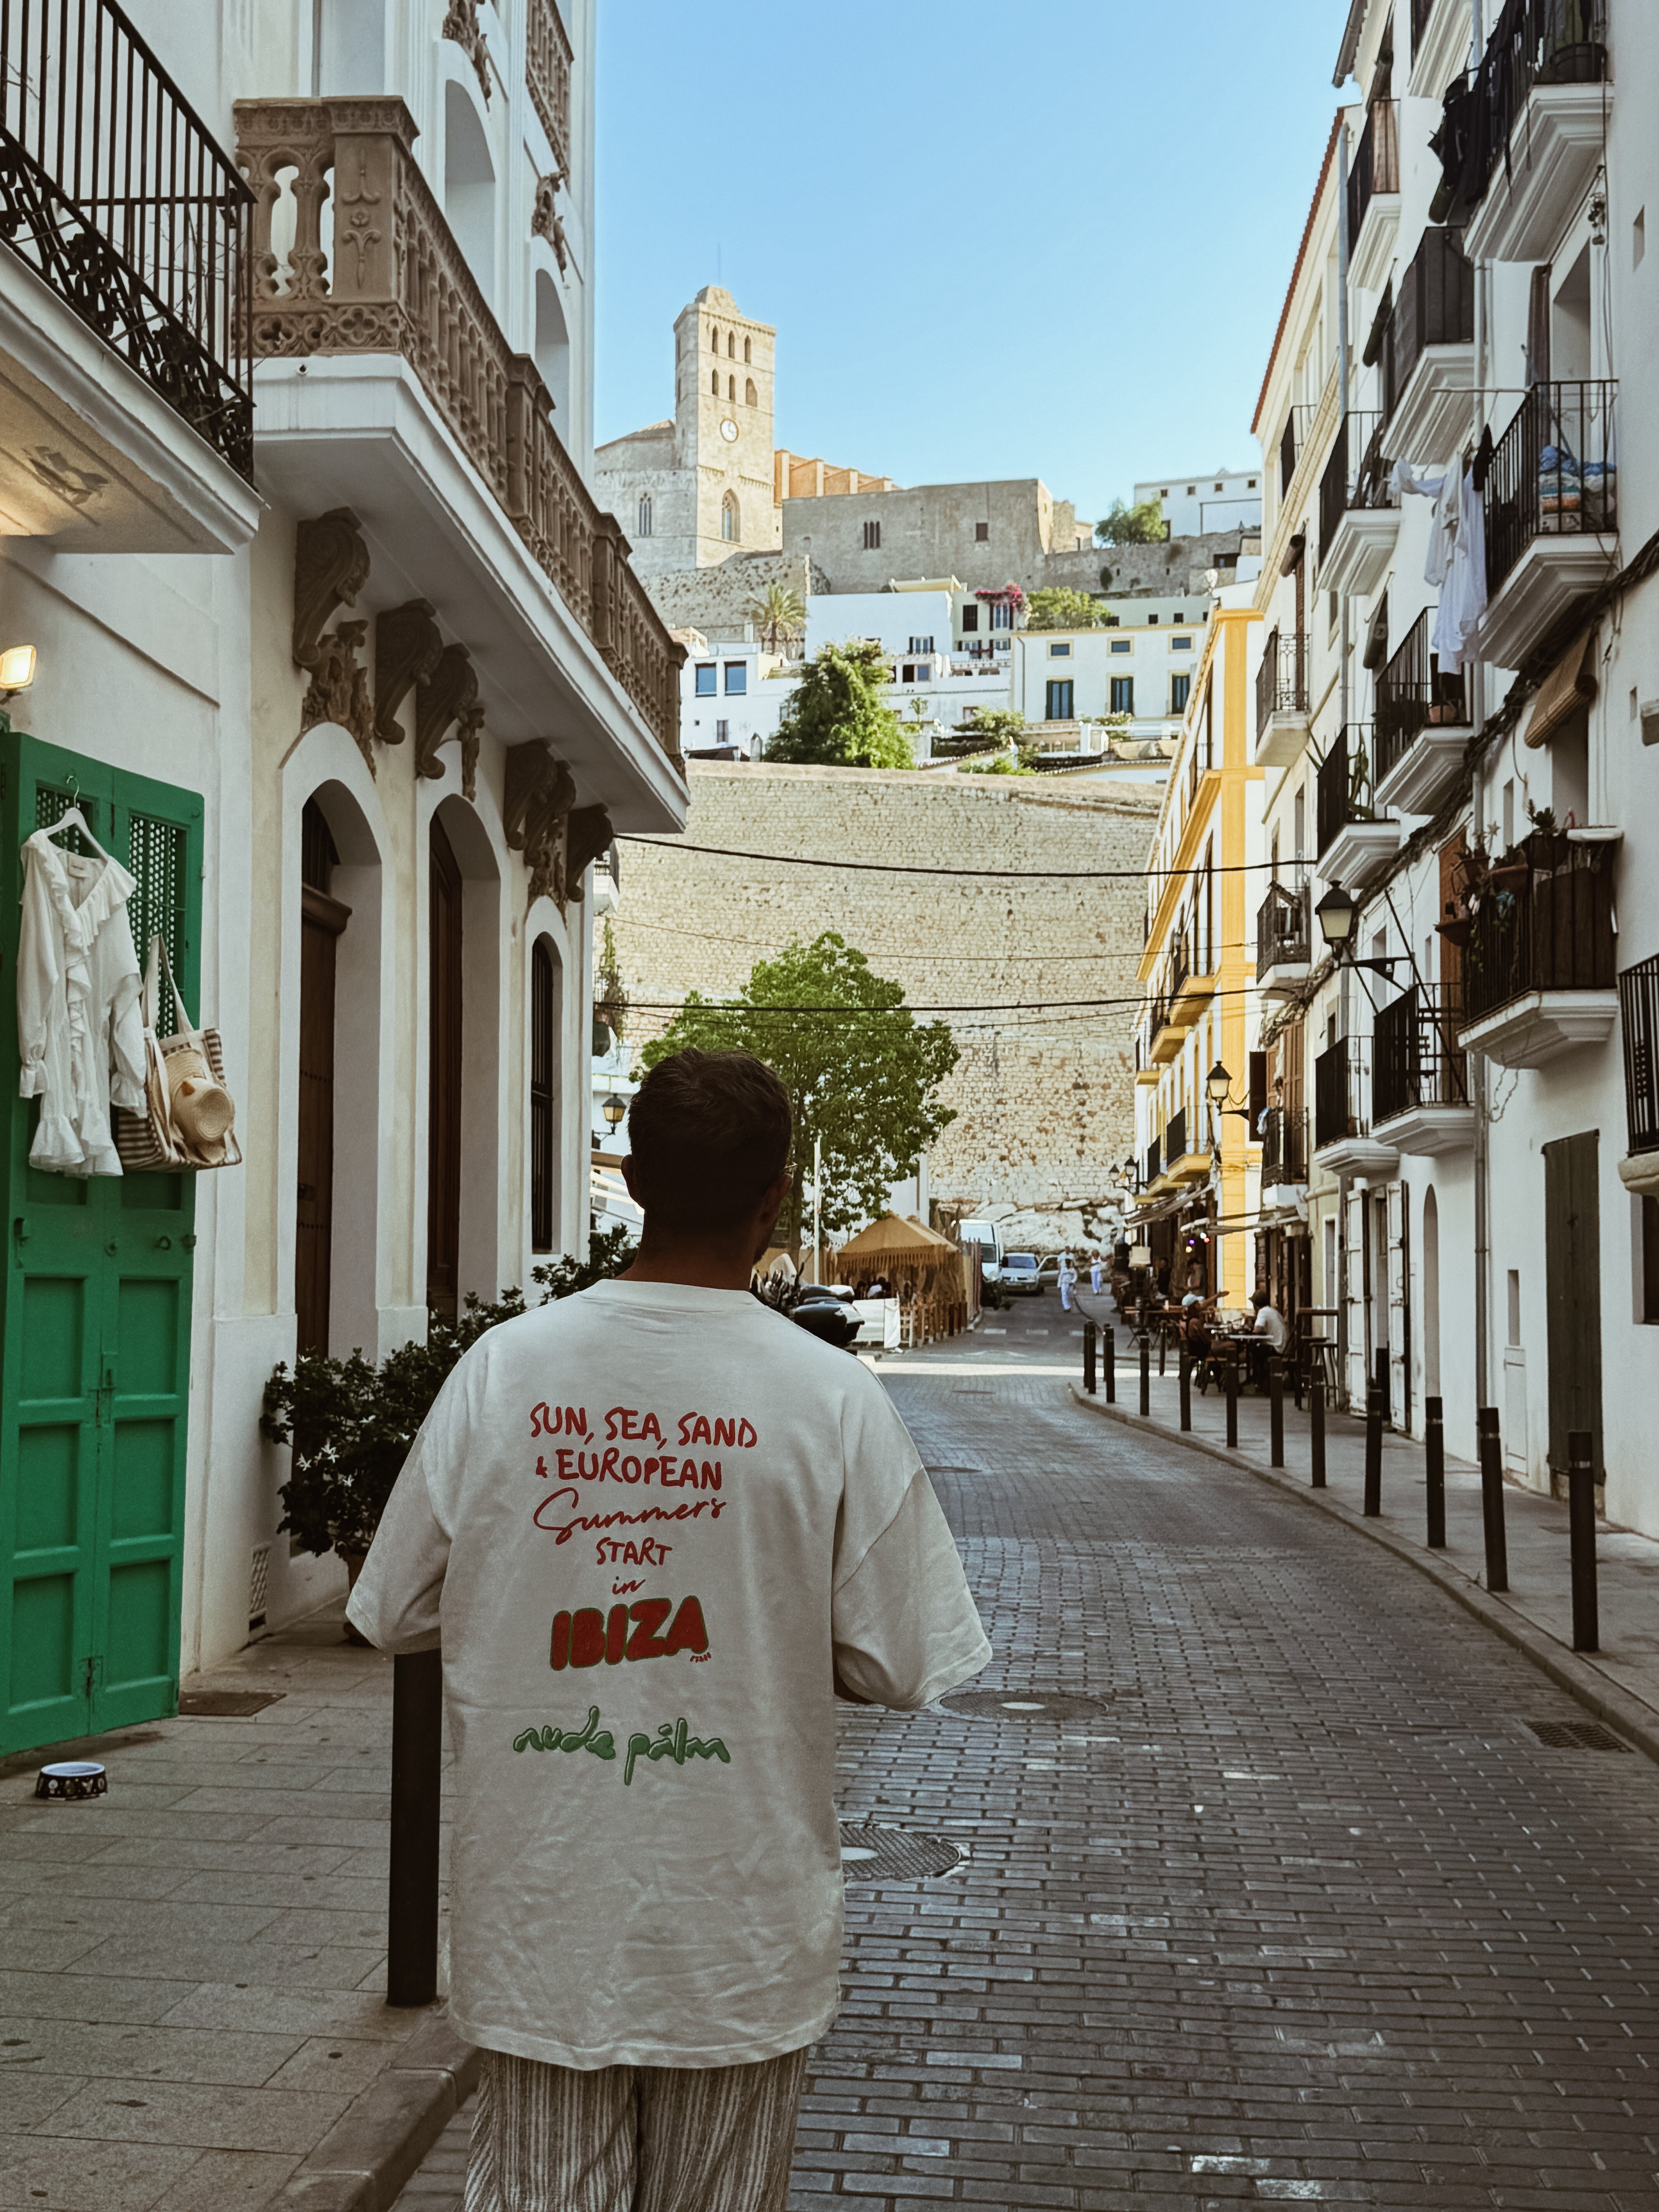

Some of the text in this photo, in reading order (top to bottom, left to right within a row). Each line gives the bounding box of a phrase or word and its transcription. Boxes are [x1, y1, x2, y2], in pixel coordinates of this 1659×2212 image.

[530, 1402, 757, 1450] SUN, SEA, SAND
[555, 1447, 722, 1491] EUROPEAN
[534, 1487, 726, 1545] Summers
[596, 1537, 672, 1566] START
[613, 1576, 645, 1595] in
[550, 1595, 709, 1671] IBIZA
[513, 1705, 616, 1760] nude
